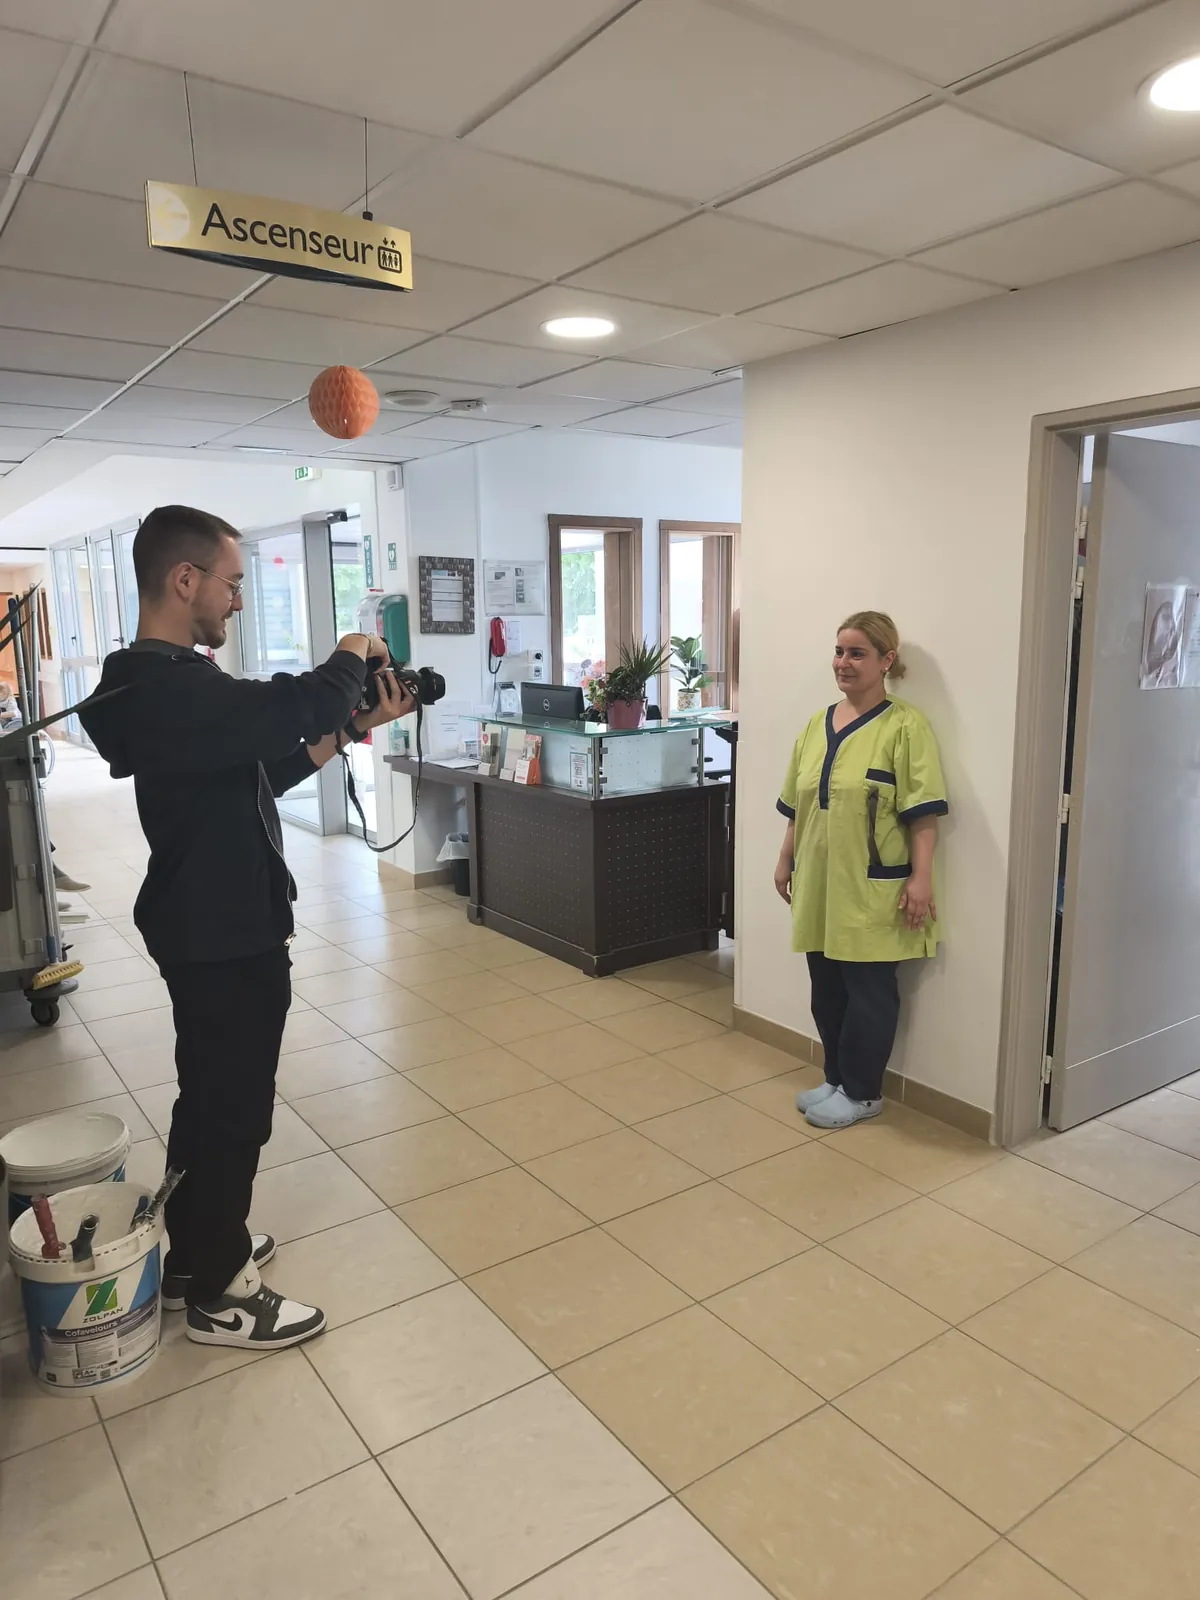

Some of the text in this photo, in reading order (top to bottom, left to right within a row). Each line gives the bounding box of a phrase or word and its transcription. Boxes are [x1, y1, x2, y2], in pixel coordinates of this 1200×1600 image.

[201, 203, 374, 265] Ascenseur
[83, 1307, 123, 1324] ZOLPAN
[65, 1321, 118, 1337] Cofavelours
